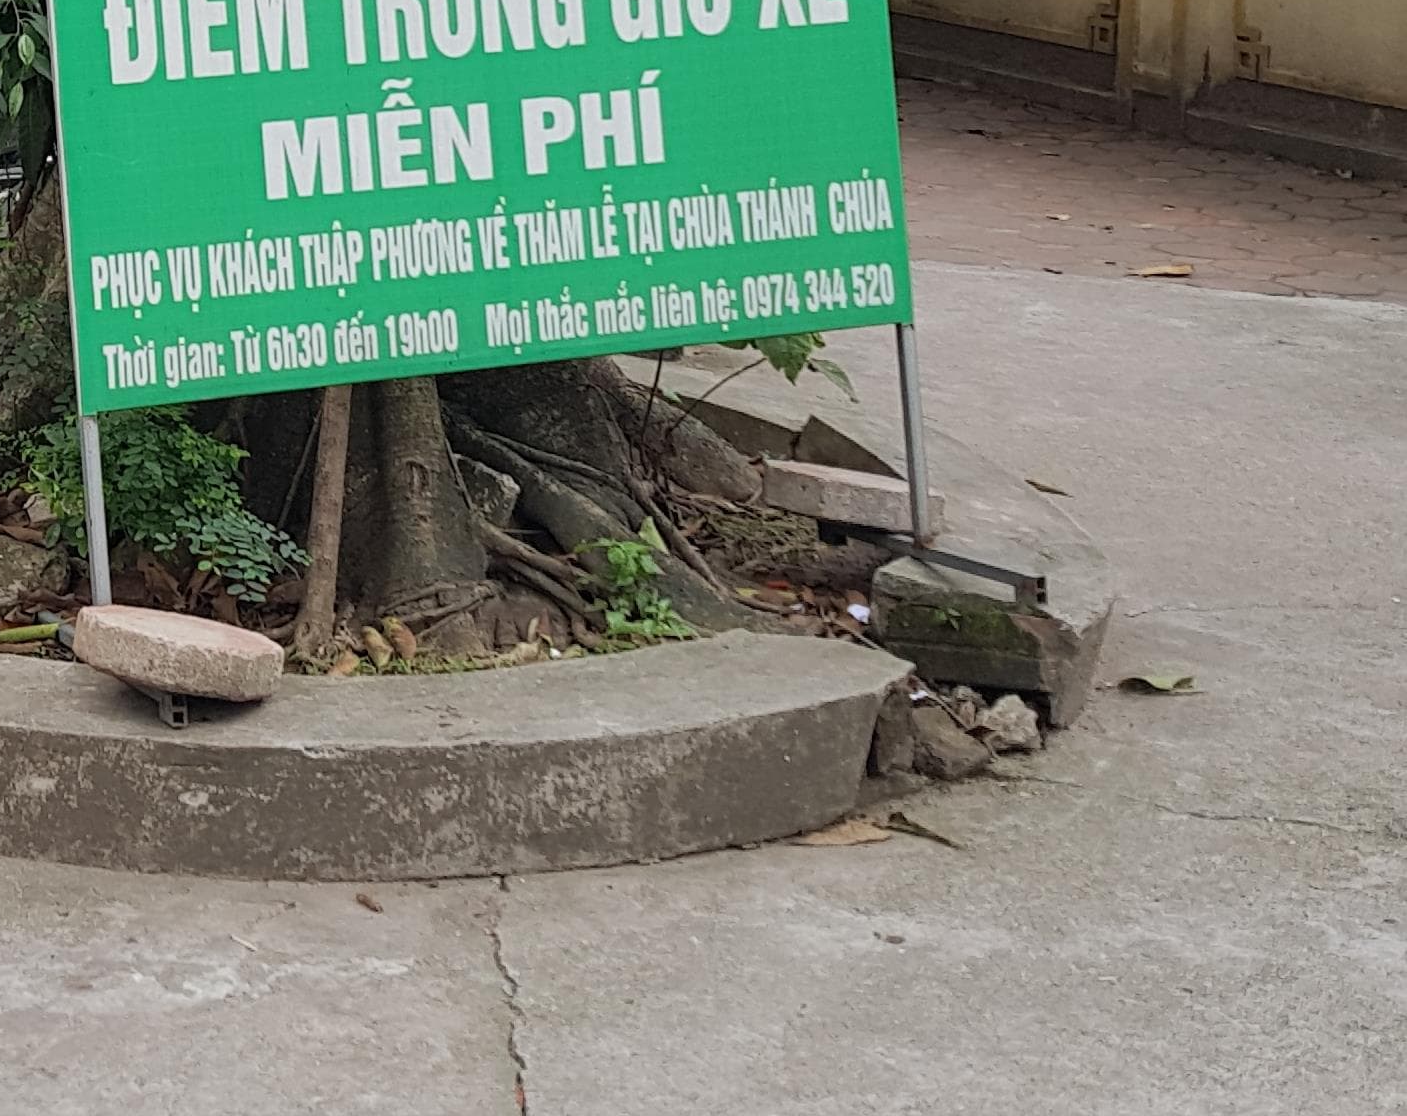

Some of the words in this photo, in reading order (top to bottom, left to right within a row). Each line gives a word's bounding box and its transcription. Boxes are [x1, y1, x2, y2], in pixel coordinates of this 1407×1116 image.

[261, 77, 494, 200] MIỄN
[520, 70, 665, 175] PHÍ
[91, 250, 162, 319] PHỤC
[167, 247, 203, 313] VỤ
[208, 229, 295, 298] KHÁCH
[299, 221, 364, 298] THẬP
[370, 219, 474, 281] PHƯƠNG
[476, 196, 511, 270] VỀ
[513, 200, 586, 266] THĂM
[589, 184, 620, 259] LỄ
[623, 200, 664, 265] TẠI
[668, 184, 735, 250] CHÙA
[736, 177, 818, 243] THÁNH
[103, 336, 157, 389] Thời
[163, 337, 226, 388] gian:
[230, 325, 261, 375] Từ
[266, 323, 328, 371] 6h30
[334, 311, 379, 364] đến
[384, 309, 459, 358] 19h00
[485, 301, 532, 355] Mọi
[536, 286, 589, 342] thắc
[594, 280, 646, 335] mắc
[651, 284, 697, 329] liên
[700, 278, 739, 331] hệ:
[742, 274, 800, 319] 0974
[805, 268, 848, 313] 344
[850, 263, 895, 308] 520
